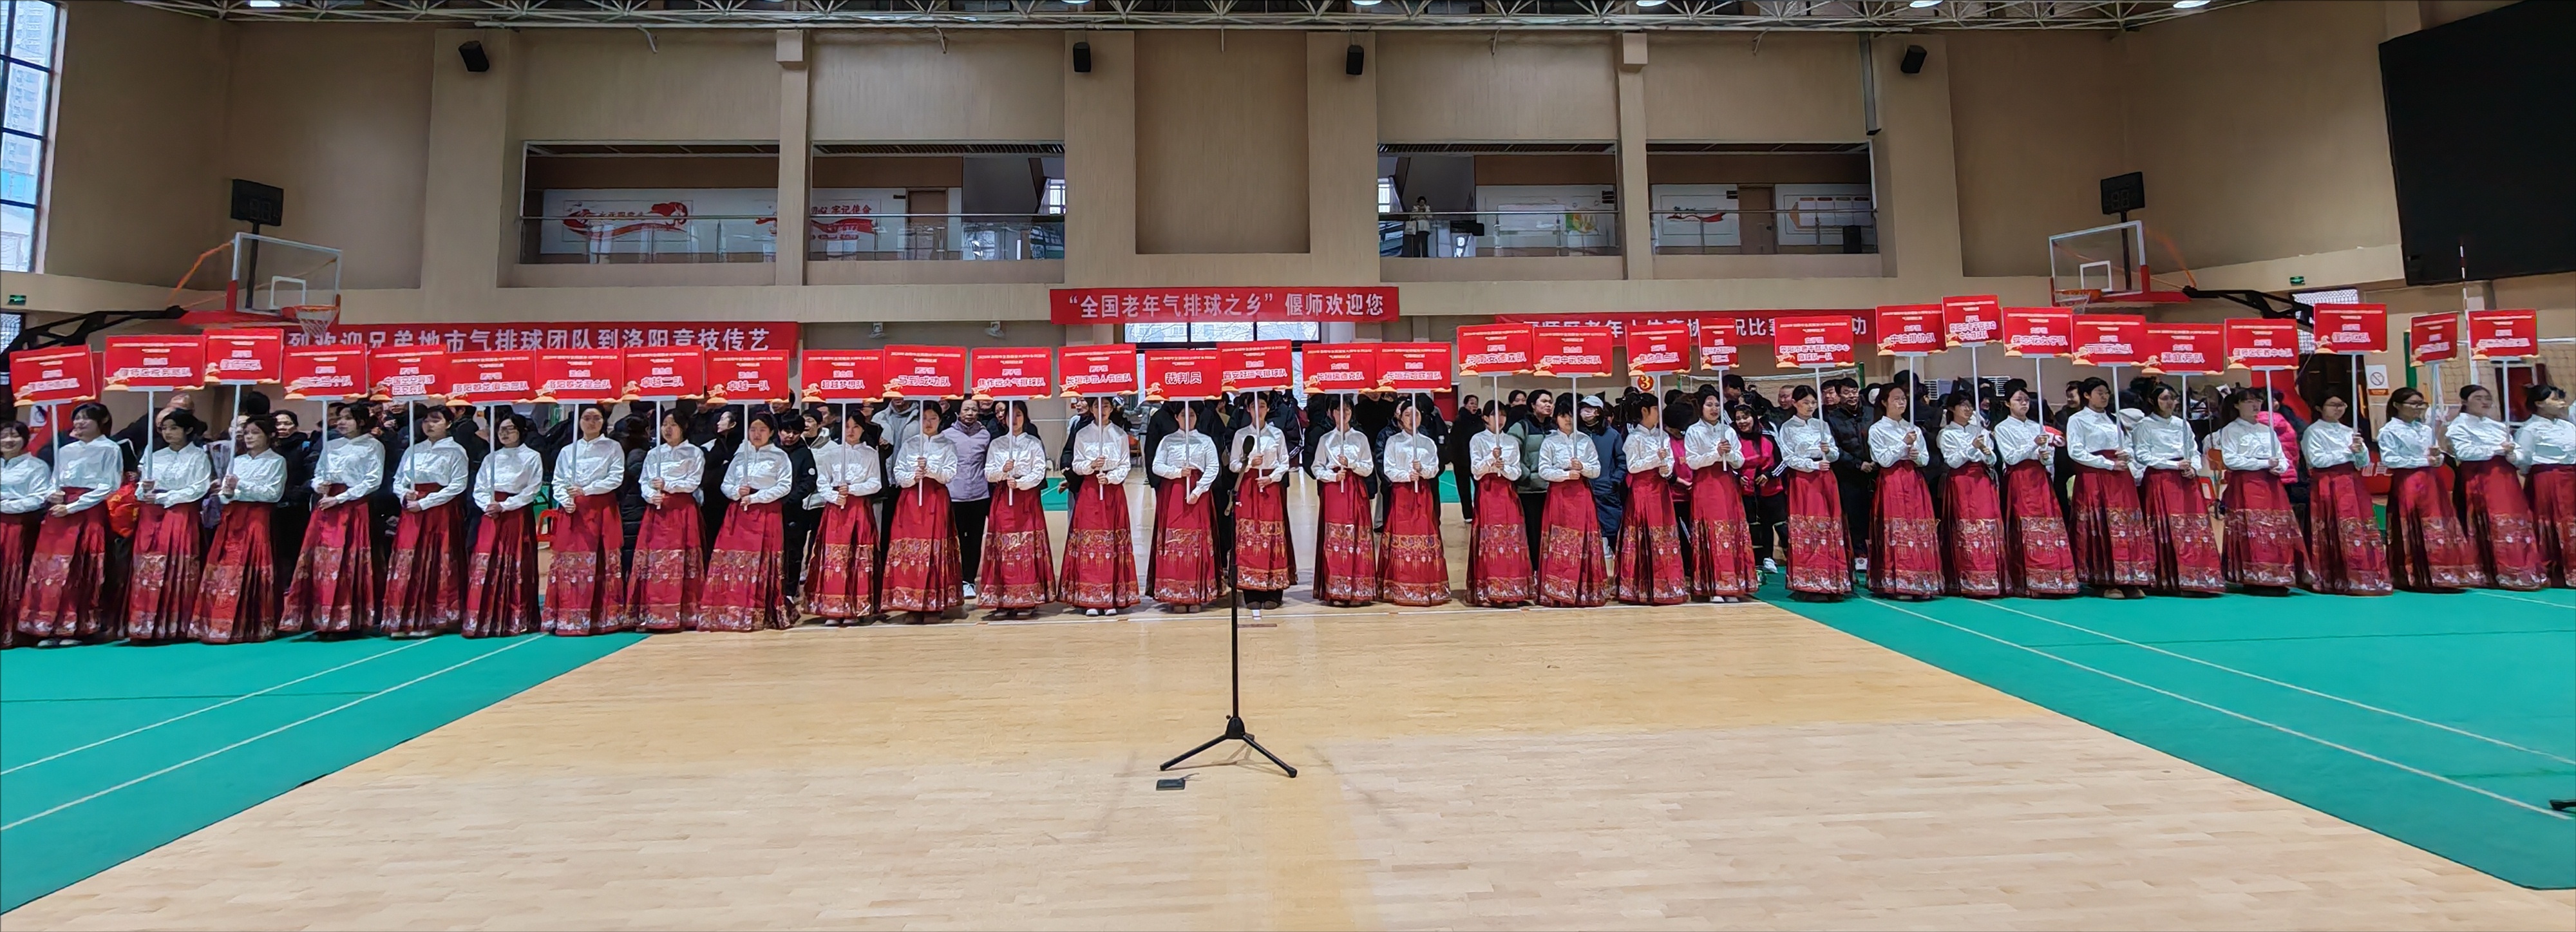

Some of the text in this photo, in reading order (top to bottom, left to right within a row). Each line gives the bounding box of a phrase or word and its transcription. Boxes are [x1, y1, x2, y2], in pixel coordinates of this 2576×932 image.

[1069, 292, 1384, 318] “全国老年气排球之乡” 偃师欢迎您
[898, 375, 951, 386] 马到成功队
[1165, 372, 1202, 385] 裁判员
